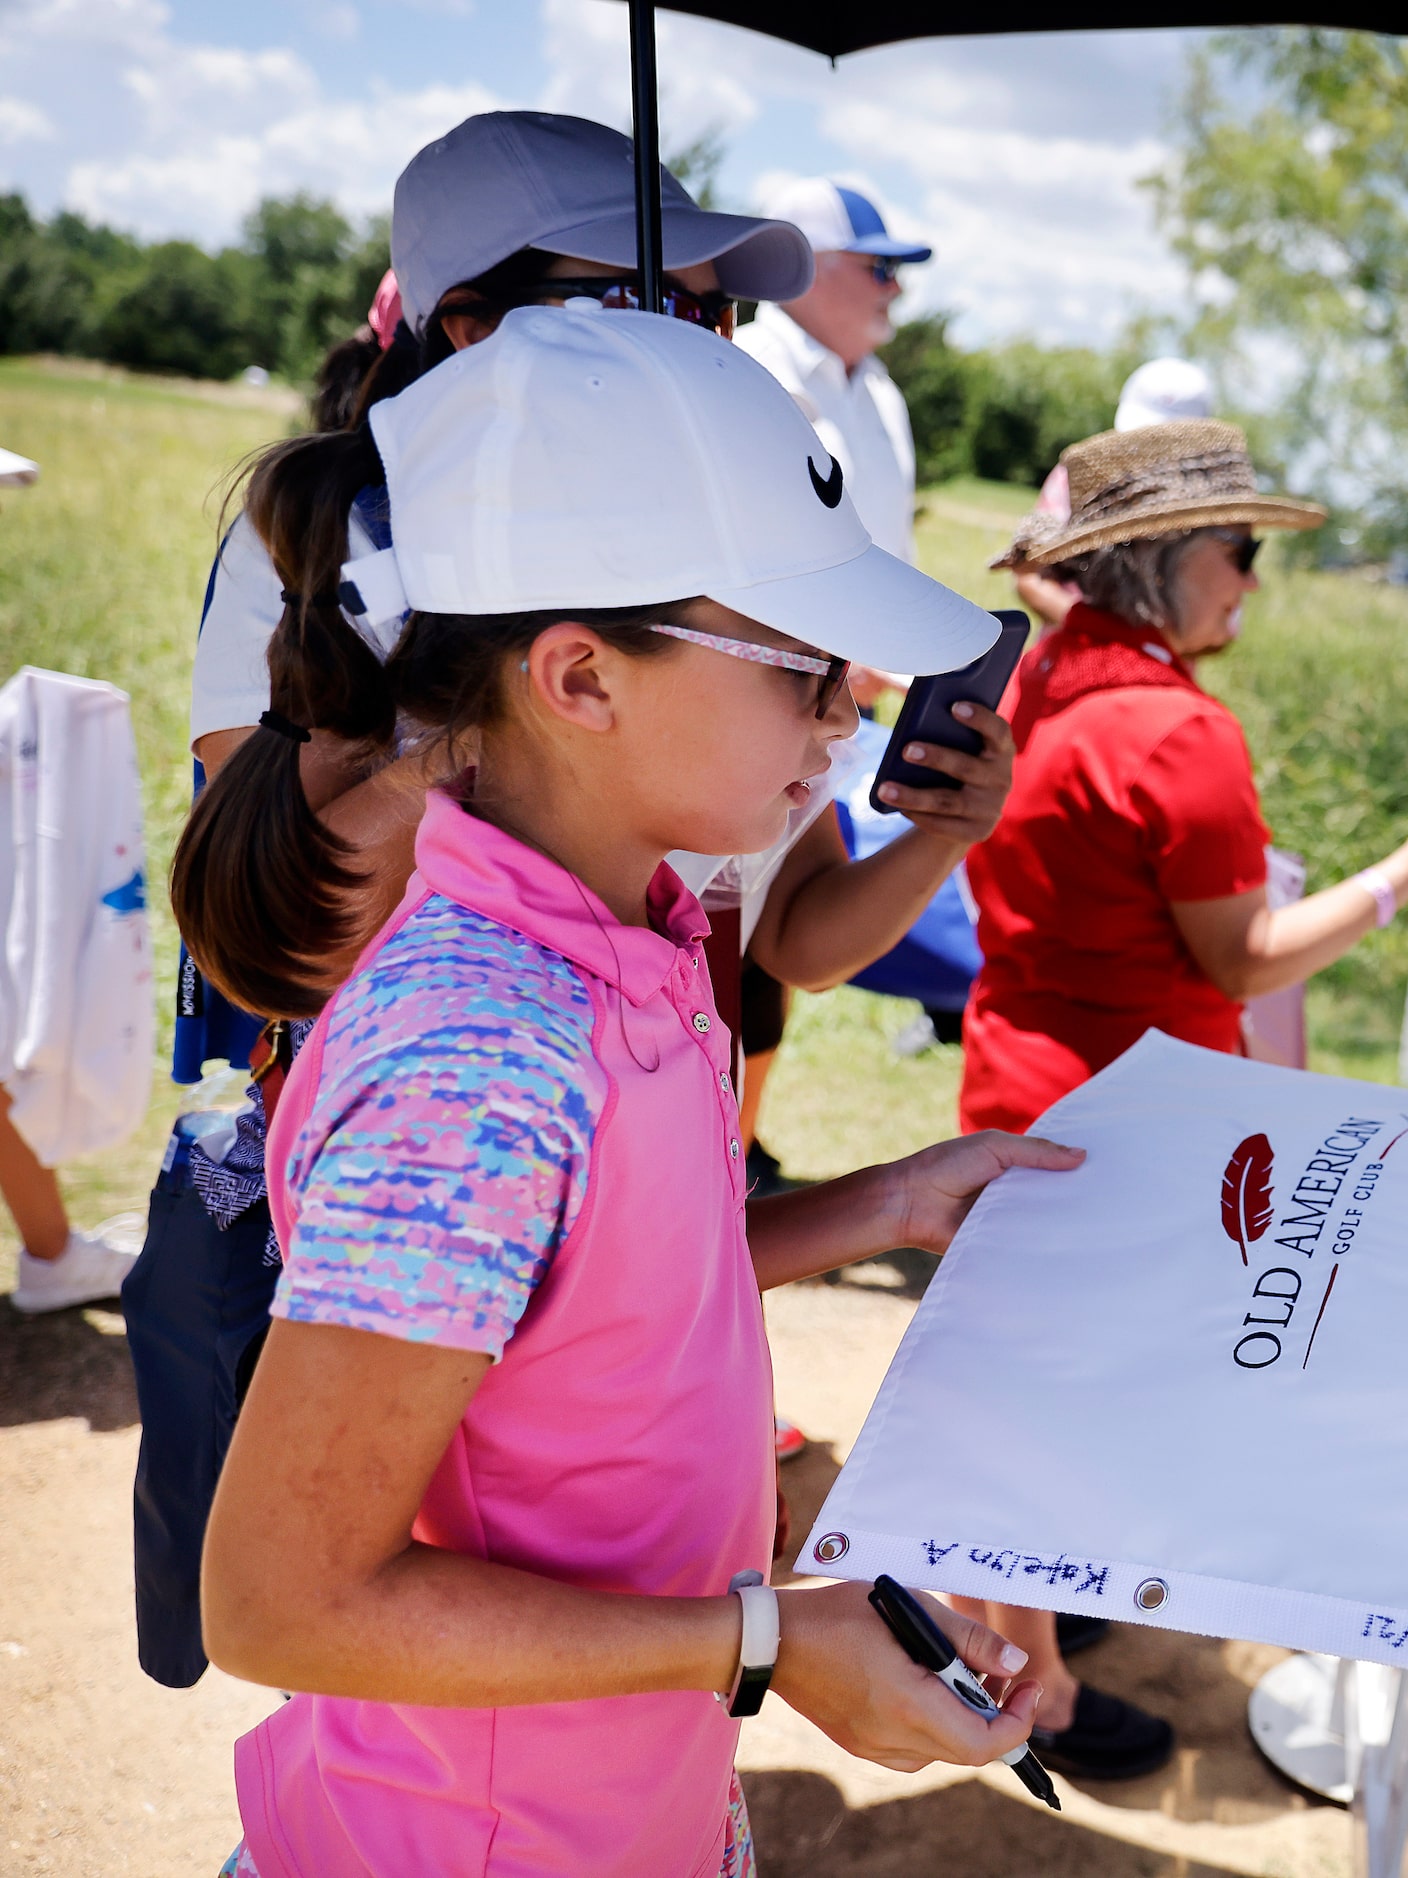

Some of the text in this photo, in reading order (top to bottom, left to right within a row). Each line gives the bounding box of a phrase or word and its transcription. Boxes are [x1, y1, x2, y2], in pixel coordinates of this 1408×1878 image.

[1233, 1116, 1386, 1370] OLD AMERICAN
[1332, 1161, 1385, 1256] GOLF CLUB
[921, 1538, 959, 1566] A
